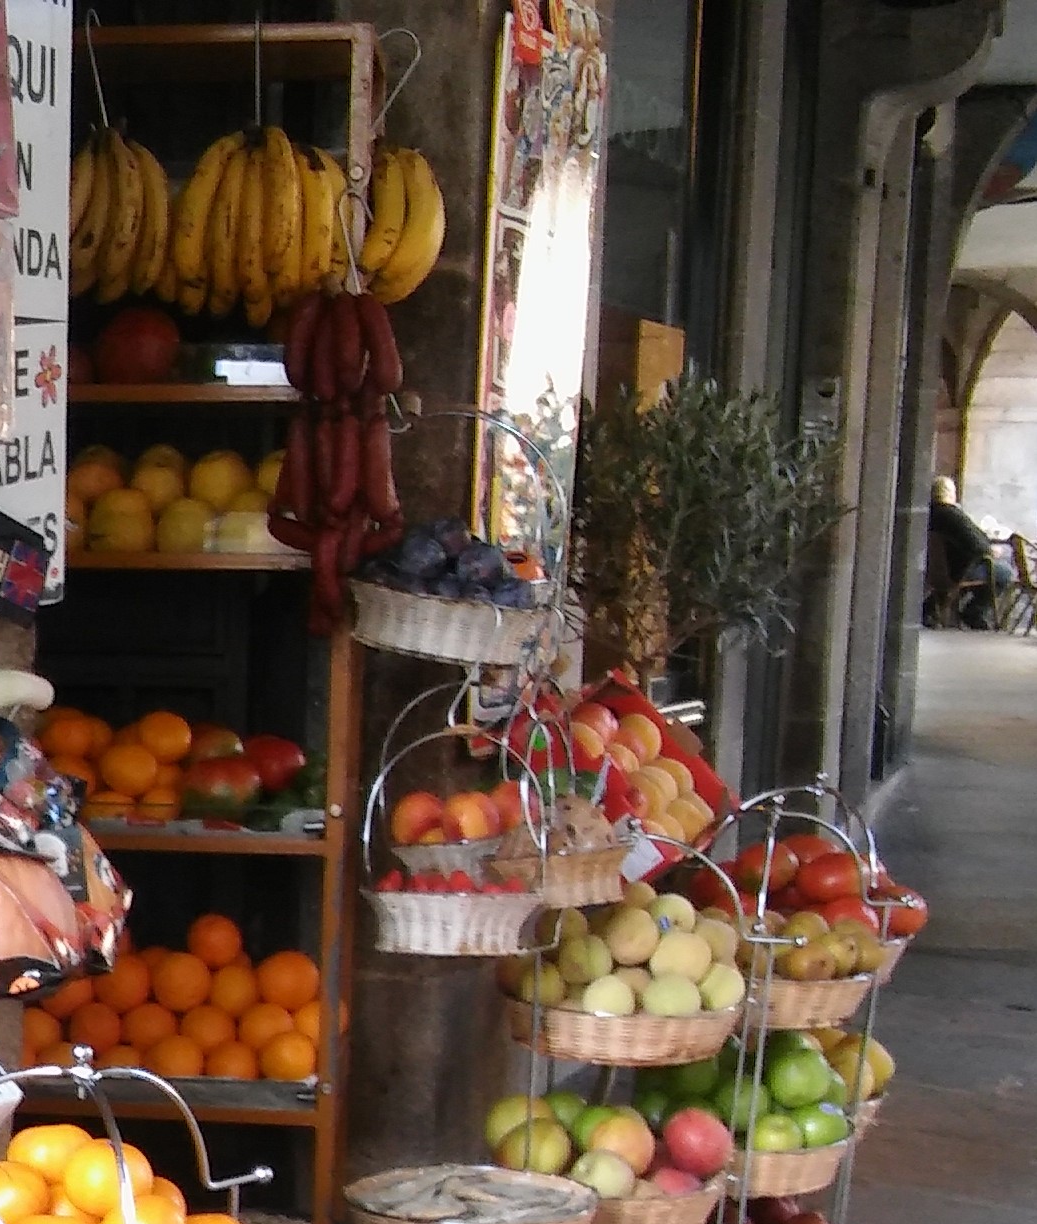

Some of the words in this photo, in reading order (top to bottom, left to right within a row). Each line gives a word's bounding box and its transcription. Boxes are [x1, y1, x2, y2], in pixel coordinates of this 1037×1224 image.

[8, 35, 56, 107] QUI
[17, 141, 32, 190] N
[13, 227, 63, 280] NDA
